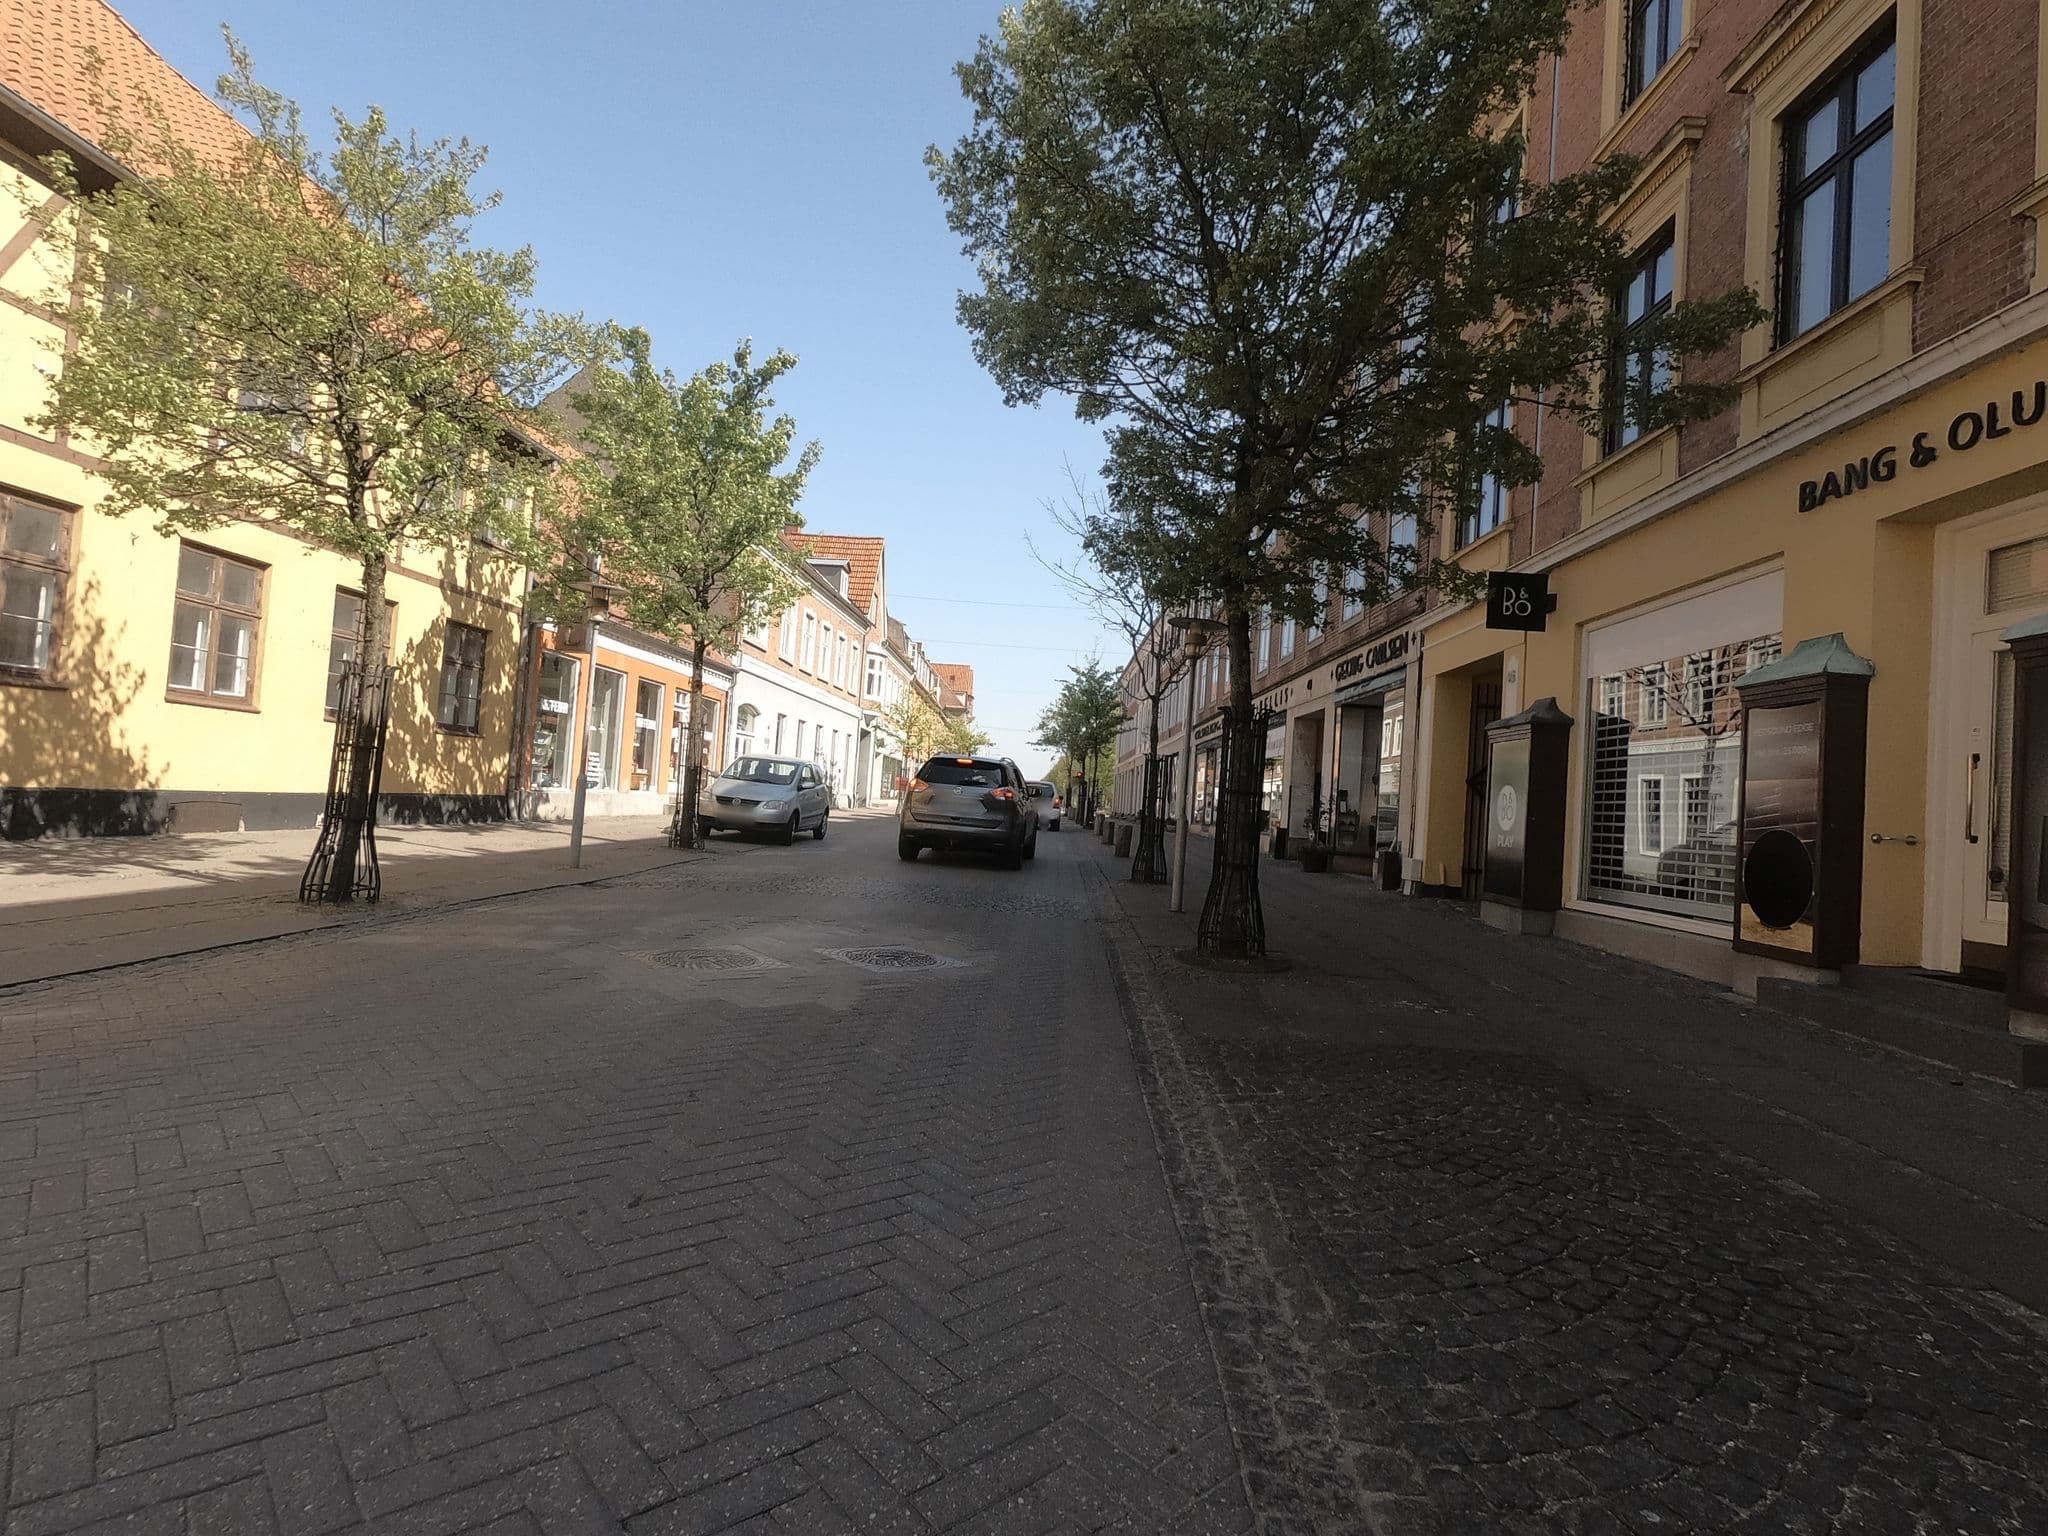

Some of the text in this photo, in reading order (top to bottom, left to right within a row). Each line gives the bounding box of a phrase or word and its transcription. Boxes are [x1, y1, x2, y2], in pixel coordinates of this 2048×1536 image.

[1798, 381, 2047, 513] BANG & OLU
